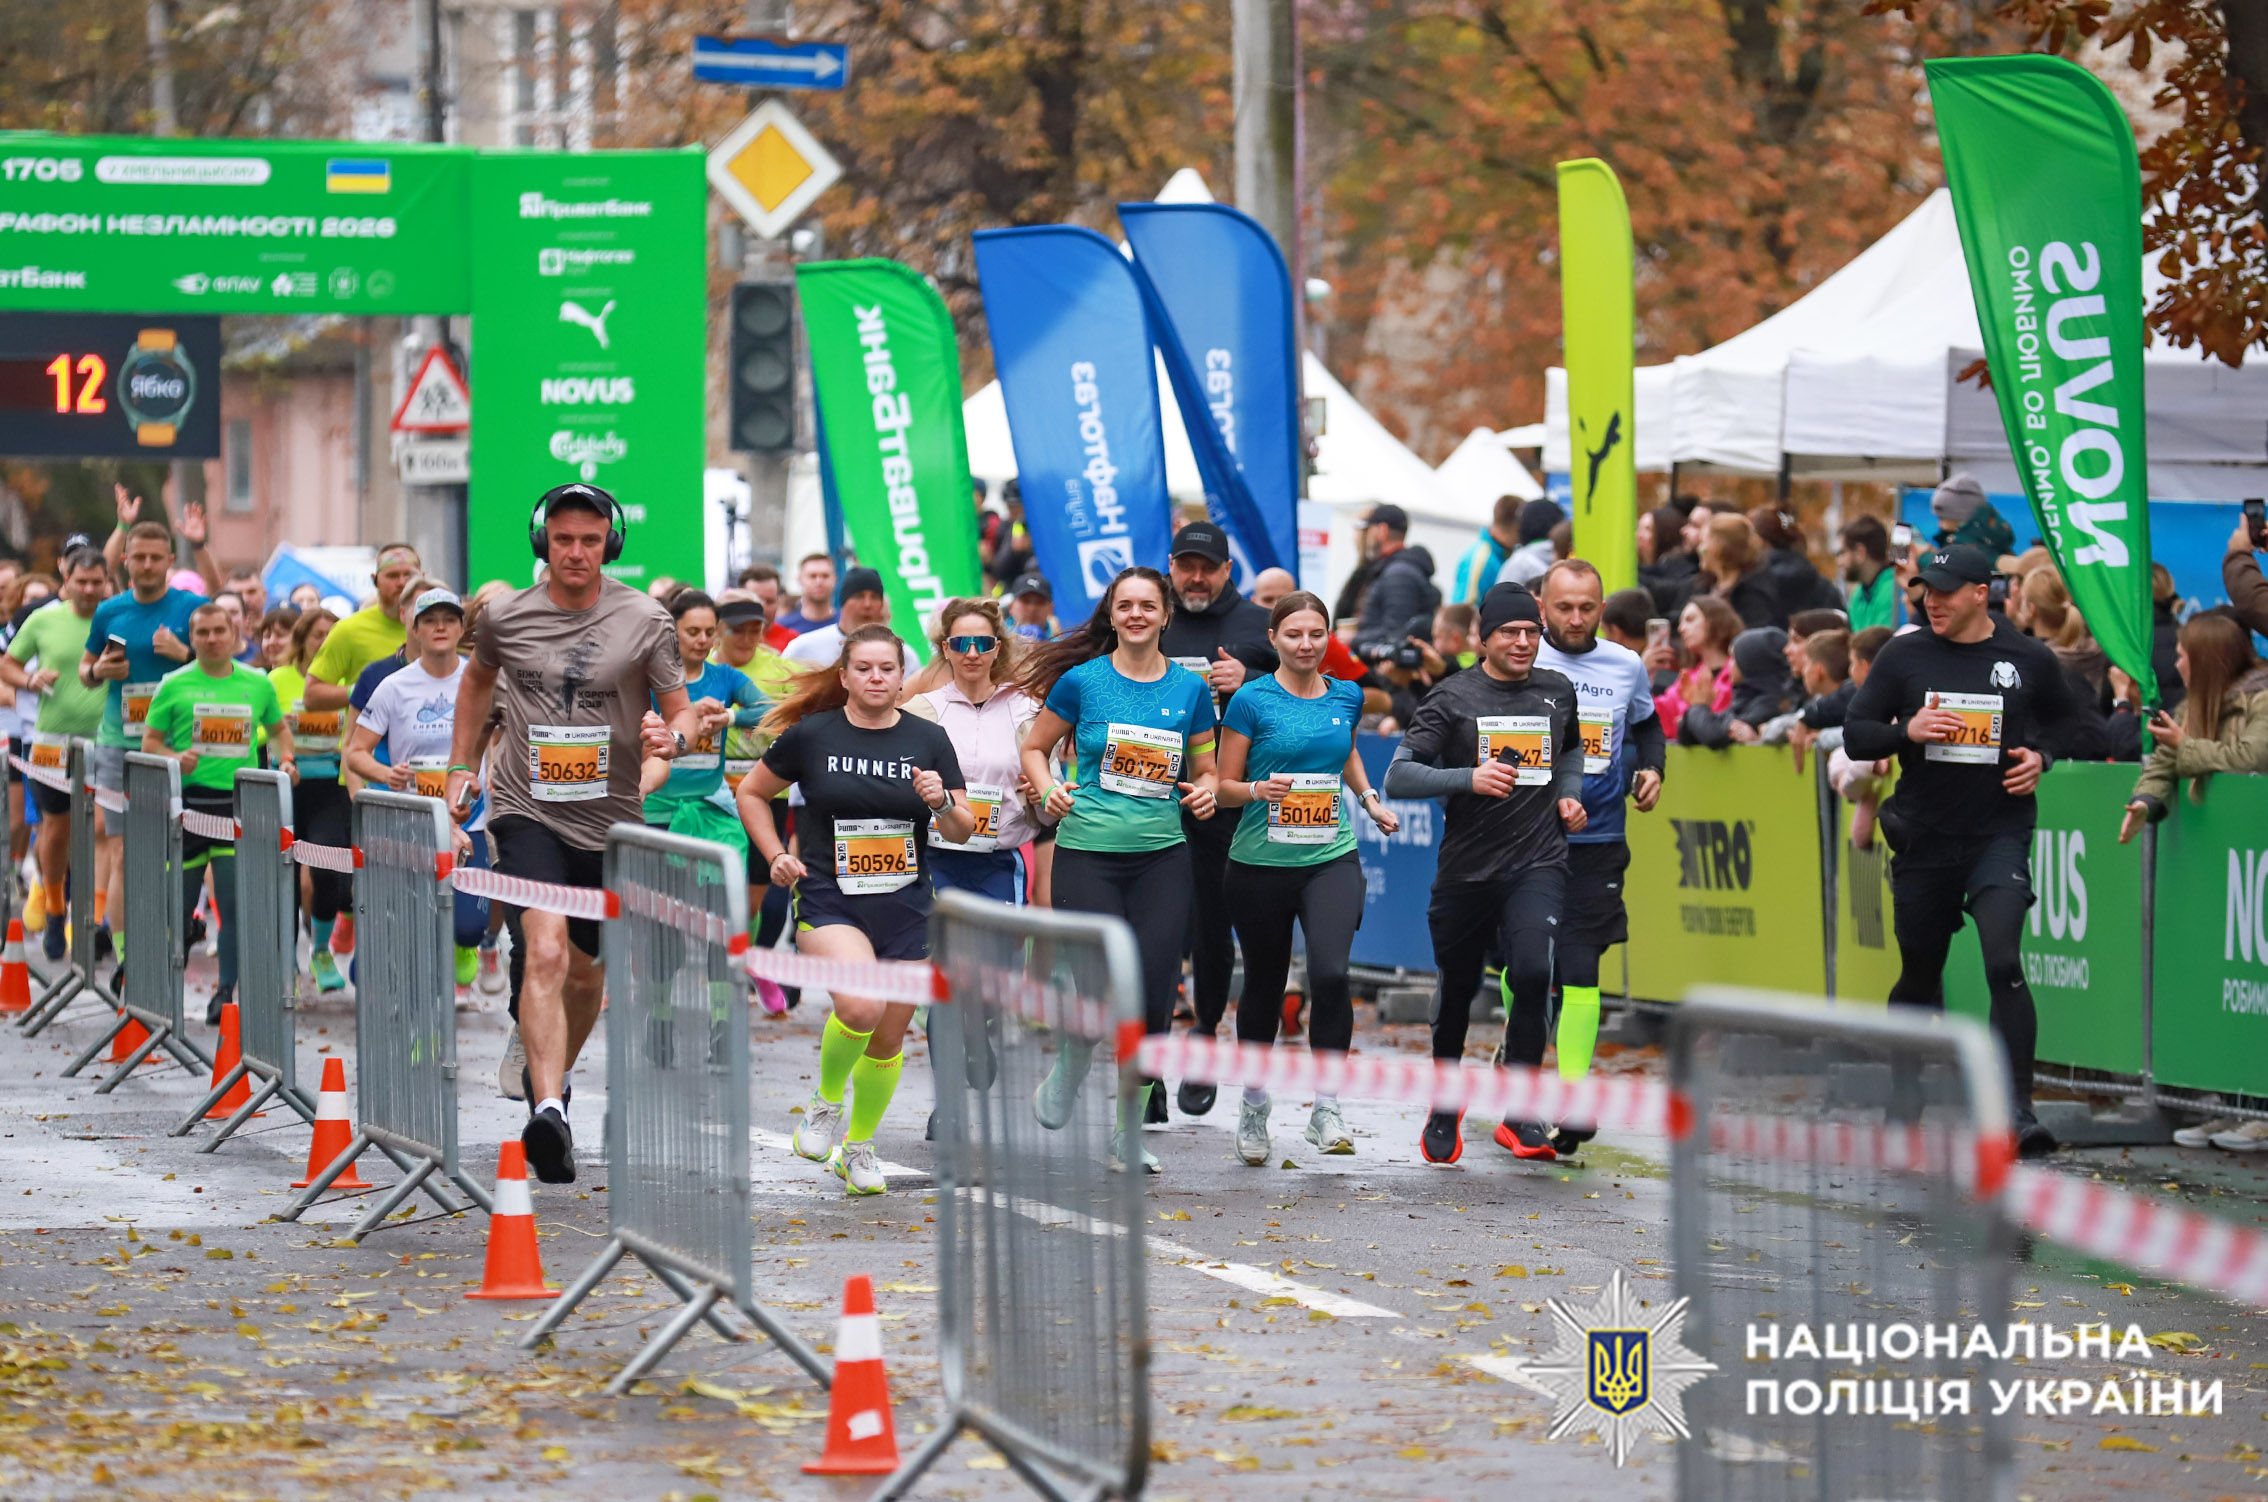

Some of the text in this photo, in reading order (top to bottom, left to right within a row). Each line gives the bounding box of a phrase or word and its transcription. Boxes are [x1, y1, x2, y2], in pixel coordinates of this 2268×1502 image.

[106, 214, 317, 237] НЕЗЛАМНОСТІ
[321, 216, 397, 238] 2026
[46, 354, 107, 414] 12
[541, 376, 635, 404] NOVUS
[578, 690, 618, 699] КОРПУС
[1581, 683, 1614, 697] Agro
[571, 731, 607, 739] UKRNAFTA
[1149, 733, 1181, 744] UKRNAFTA
[540, 761, 597, 780] 50632
[828, 756, 912, 780] RUNNER
[1113, 756, 1168, 780] 50177
[969, 788, 1000, 797] UKRNAFTA
[1281, 807, 1330, 824] 50140
[838, 823, 911, 832] PUMA UKRNAFTA
[849, 854, 906, 873] 50596
